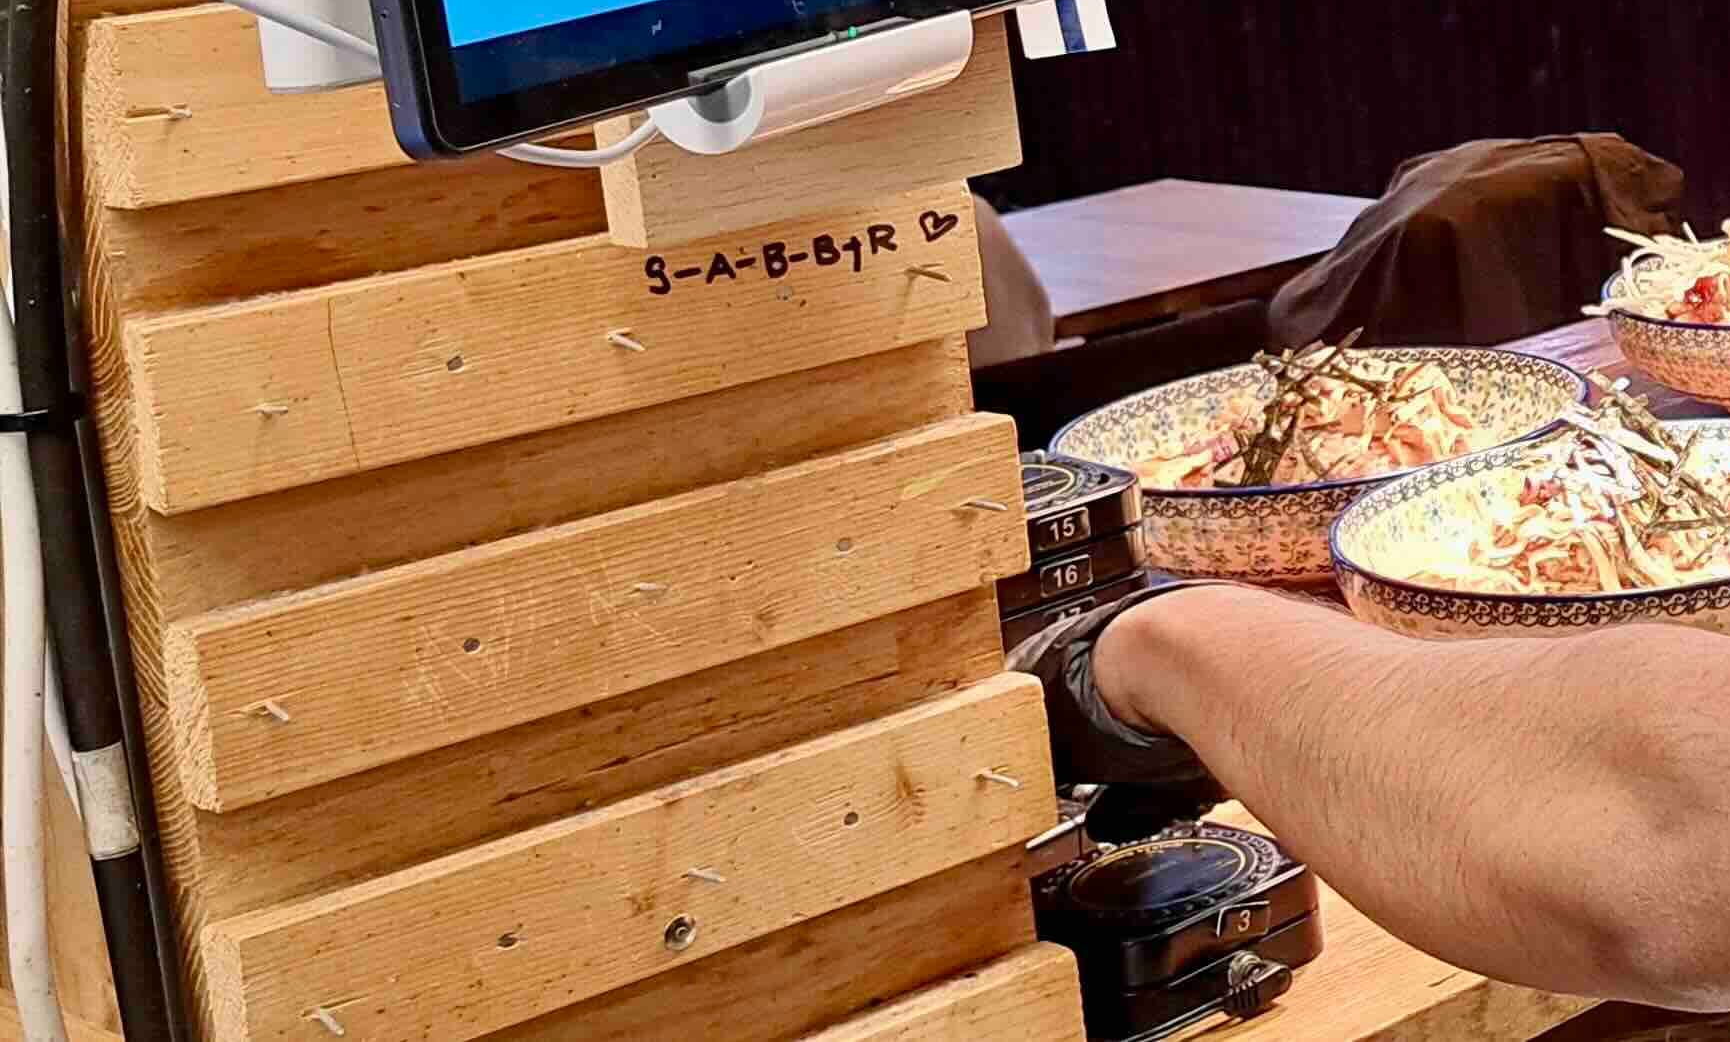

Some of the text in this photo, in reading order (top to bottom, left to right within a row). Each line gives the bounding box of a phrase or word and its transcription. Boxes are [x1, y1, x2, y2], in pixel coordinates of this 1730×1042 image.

[1050, 516, 1076, 542] 15
[1053, 564, 1079, 589] 16
[1237, 910, 1250, 933] 3
